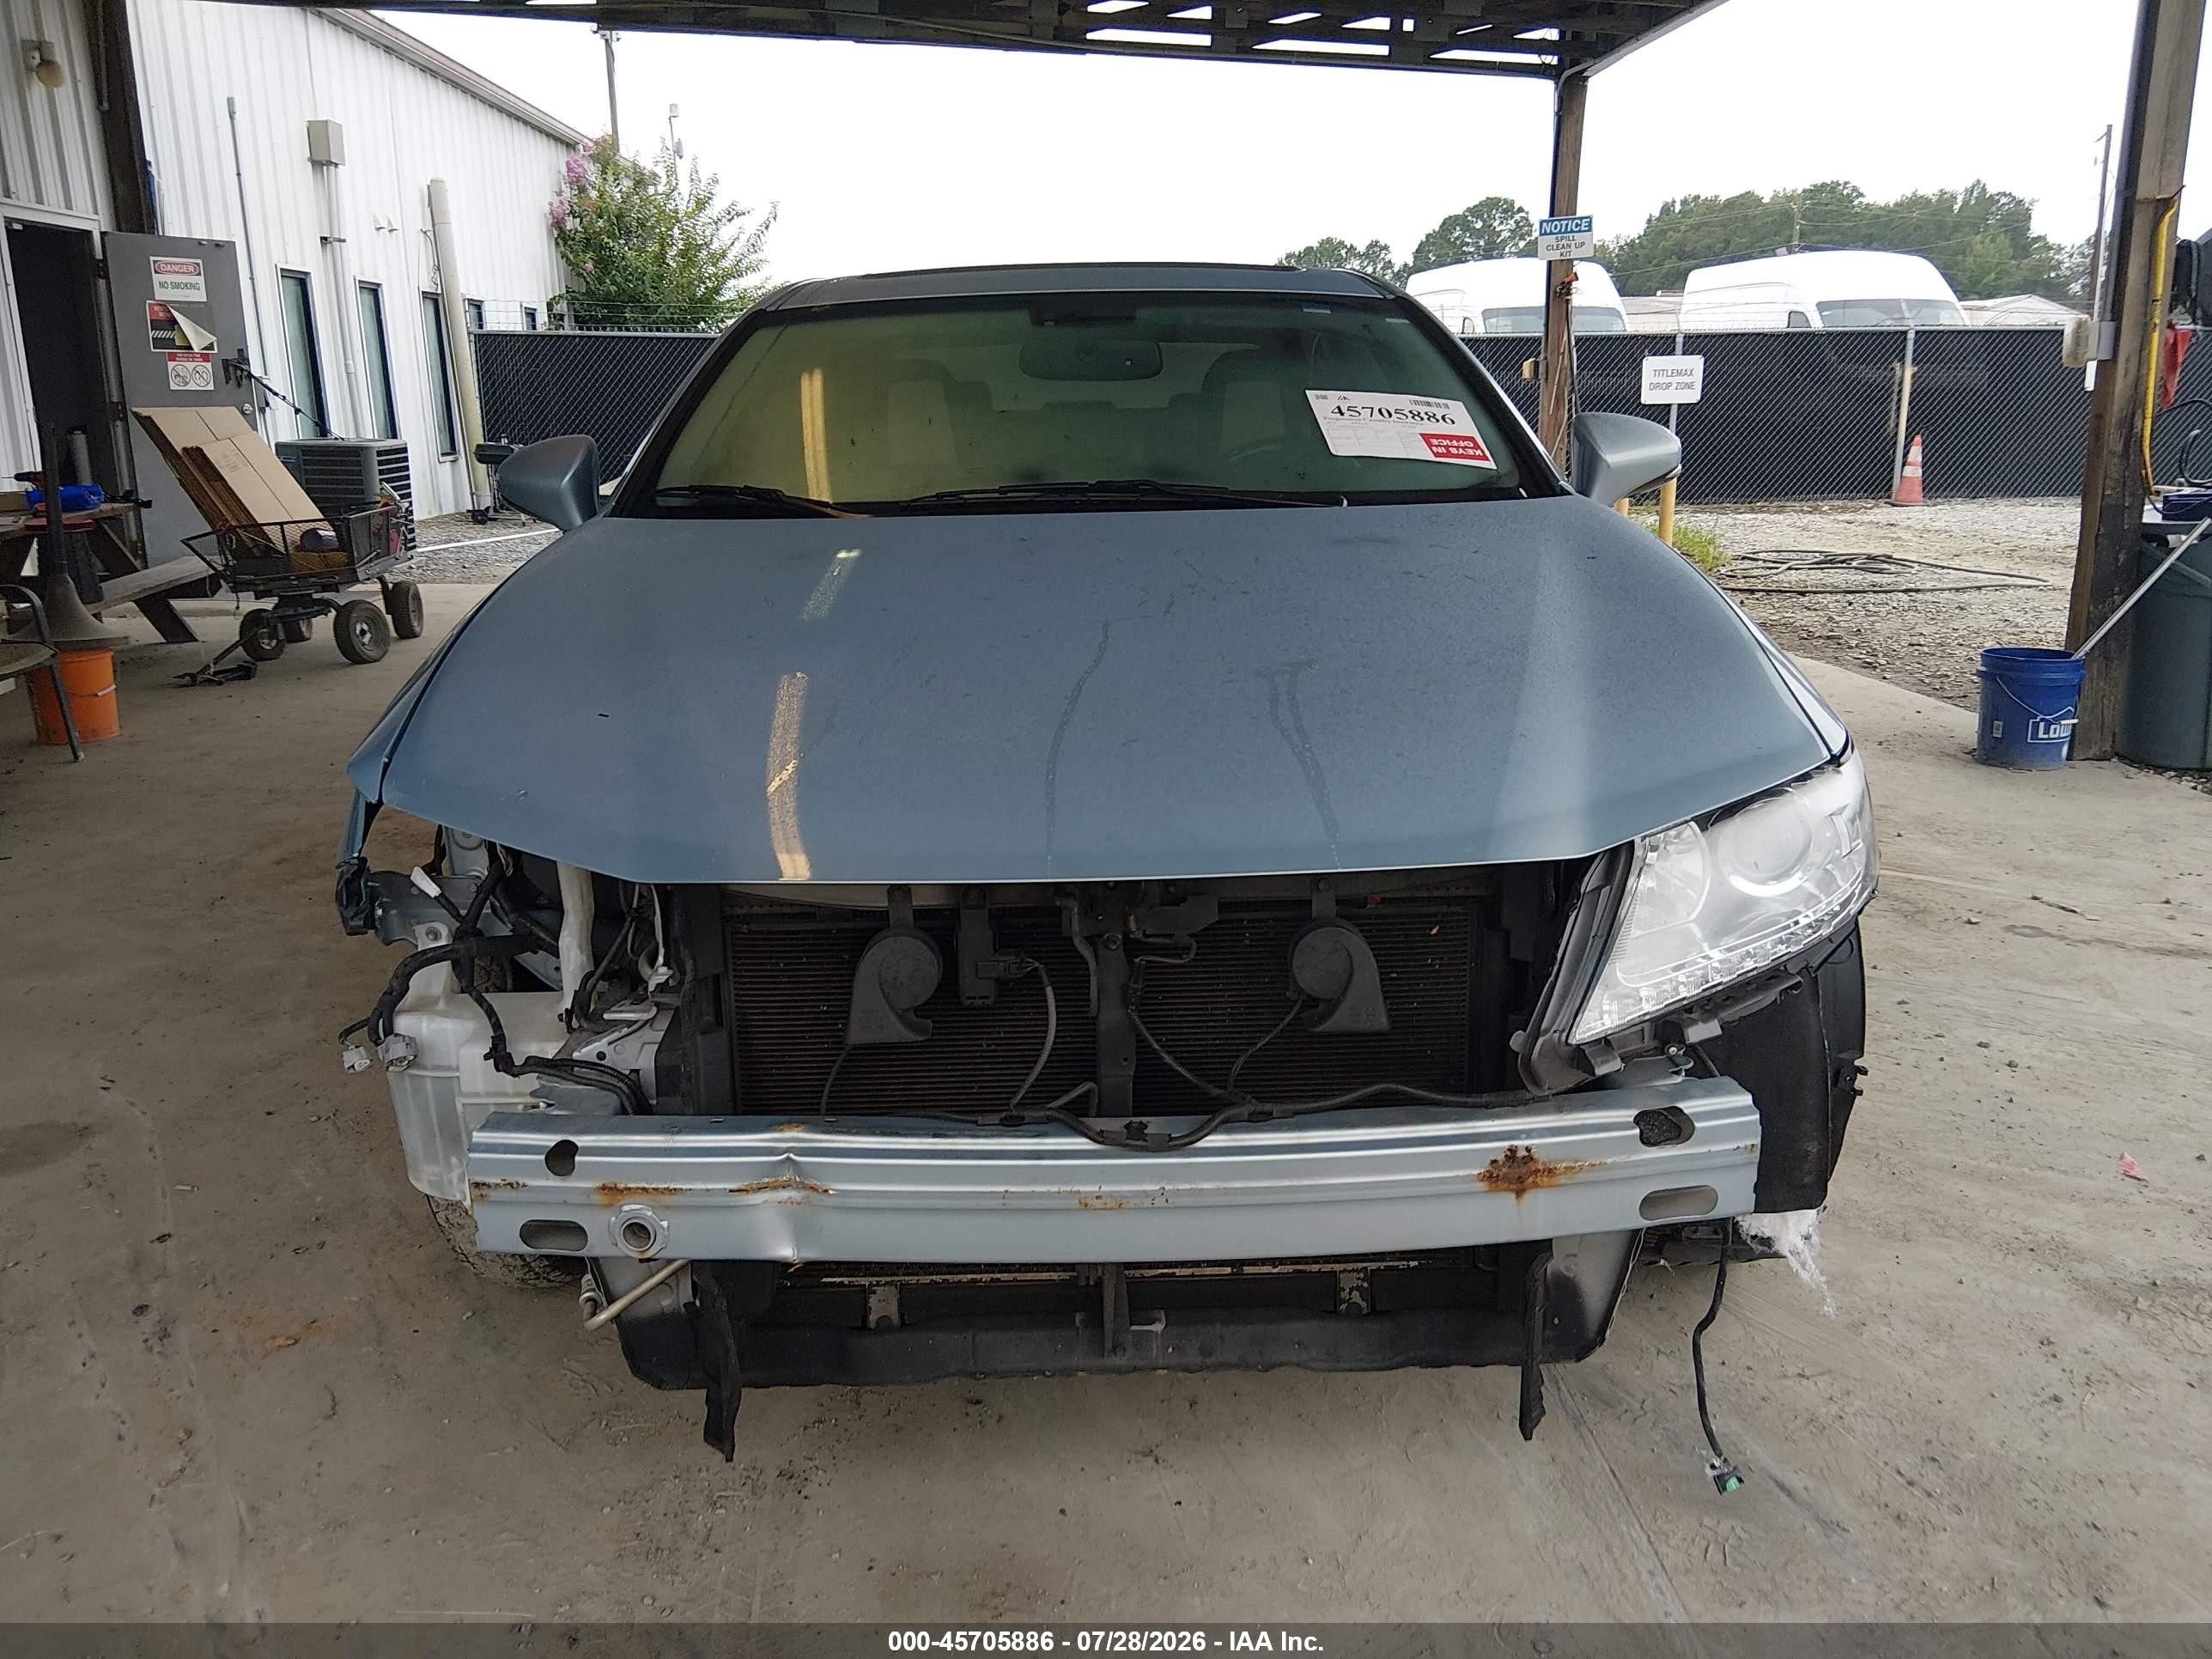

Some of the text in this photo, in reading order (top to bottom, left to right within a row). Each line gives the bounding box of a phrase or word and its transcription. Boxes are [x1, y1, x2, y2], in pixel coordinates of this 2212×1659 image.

[1541, 218, 1590, 234] NOTICE
[1546, 243, 1571, 252] CLEAN
[160, 264, 195, 273] DANGER
[159, 281, 200, 291] NO SMOKING
[1652, 368, 1695, 378] TITLEMAX
[1649, 381, 1696, 391] DROP ZONE
[1330, 405, 1456, 426] 45705886
[1429, 438, 1474, 447] OFFICE
[1431, 446, 1484, 456] KEYS IN
[2038, 722, 2071, 738] LOW
